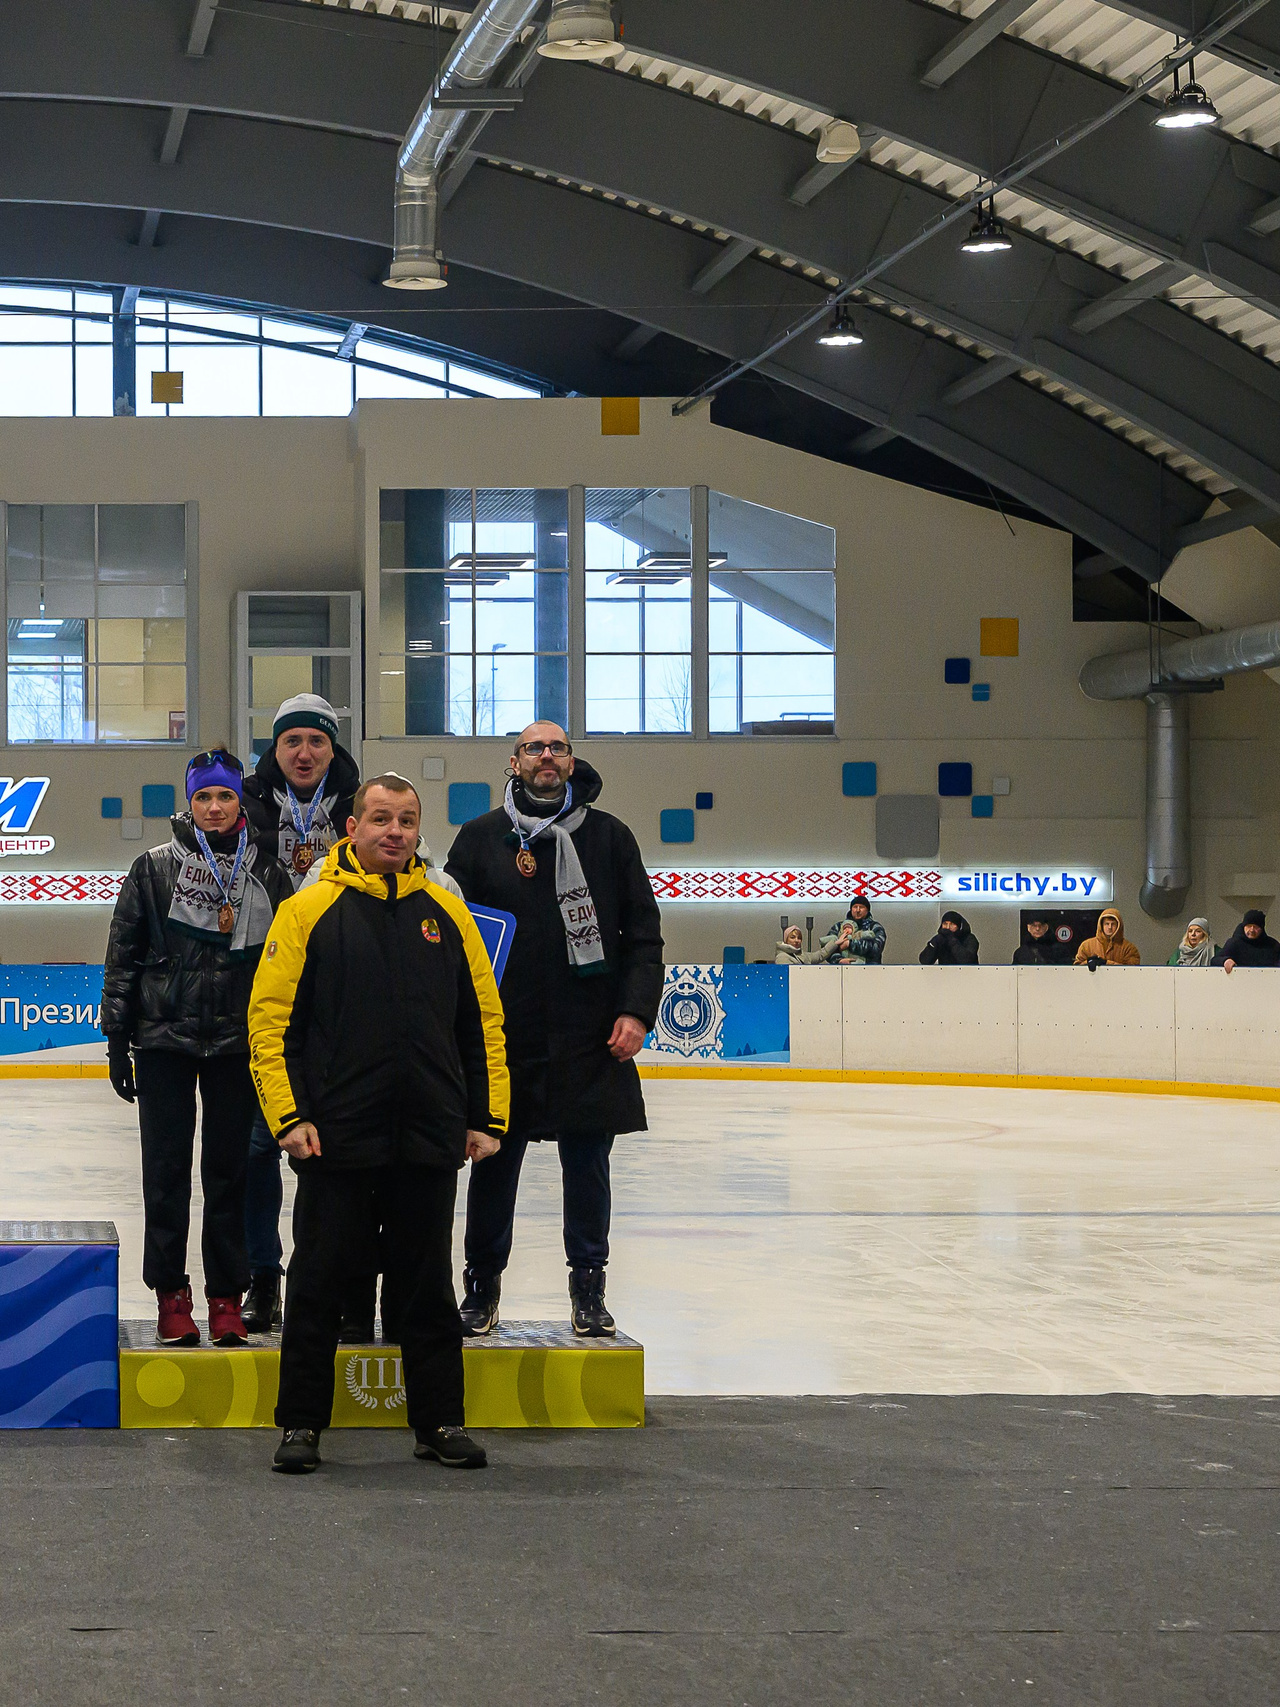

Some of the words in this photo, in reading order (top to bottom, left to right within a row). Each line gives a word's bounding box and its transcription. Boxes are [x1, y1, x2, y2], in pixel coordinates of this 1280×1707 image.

[958, 872, 1097, 896] silichy.by
[252, 1044, 268, 1107] BEARUS
[357, 1357, 405, 1389] III
